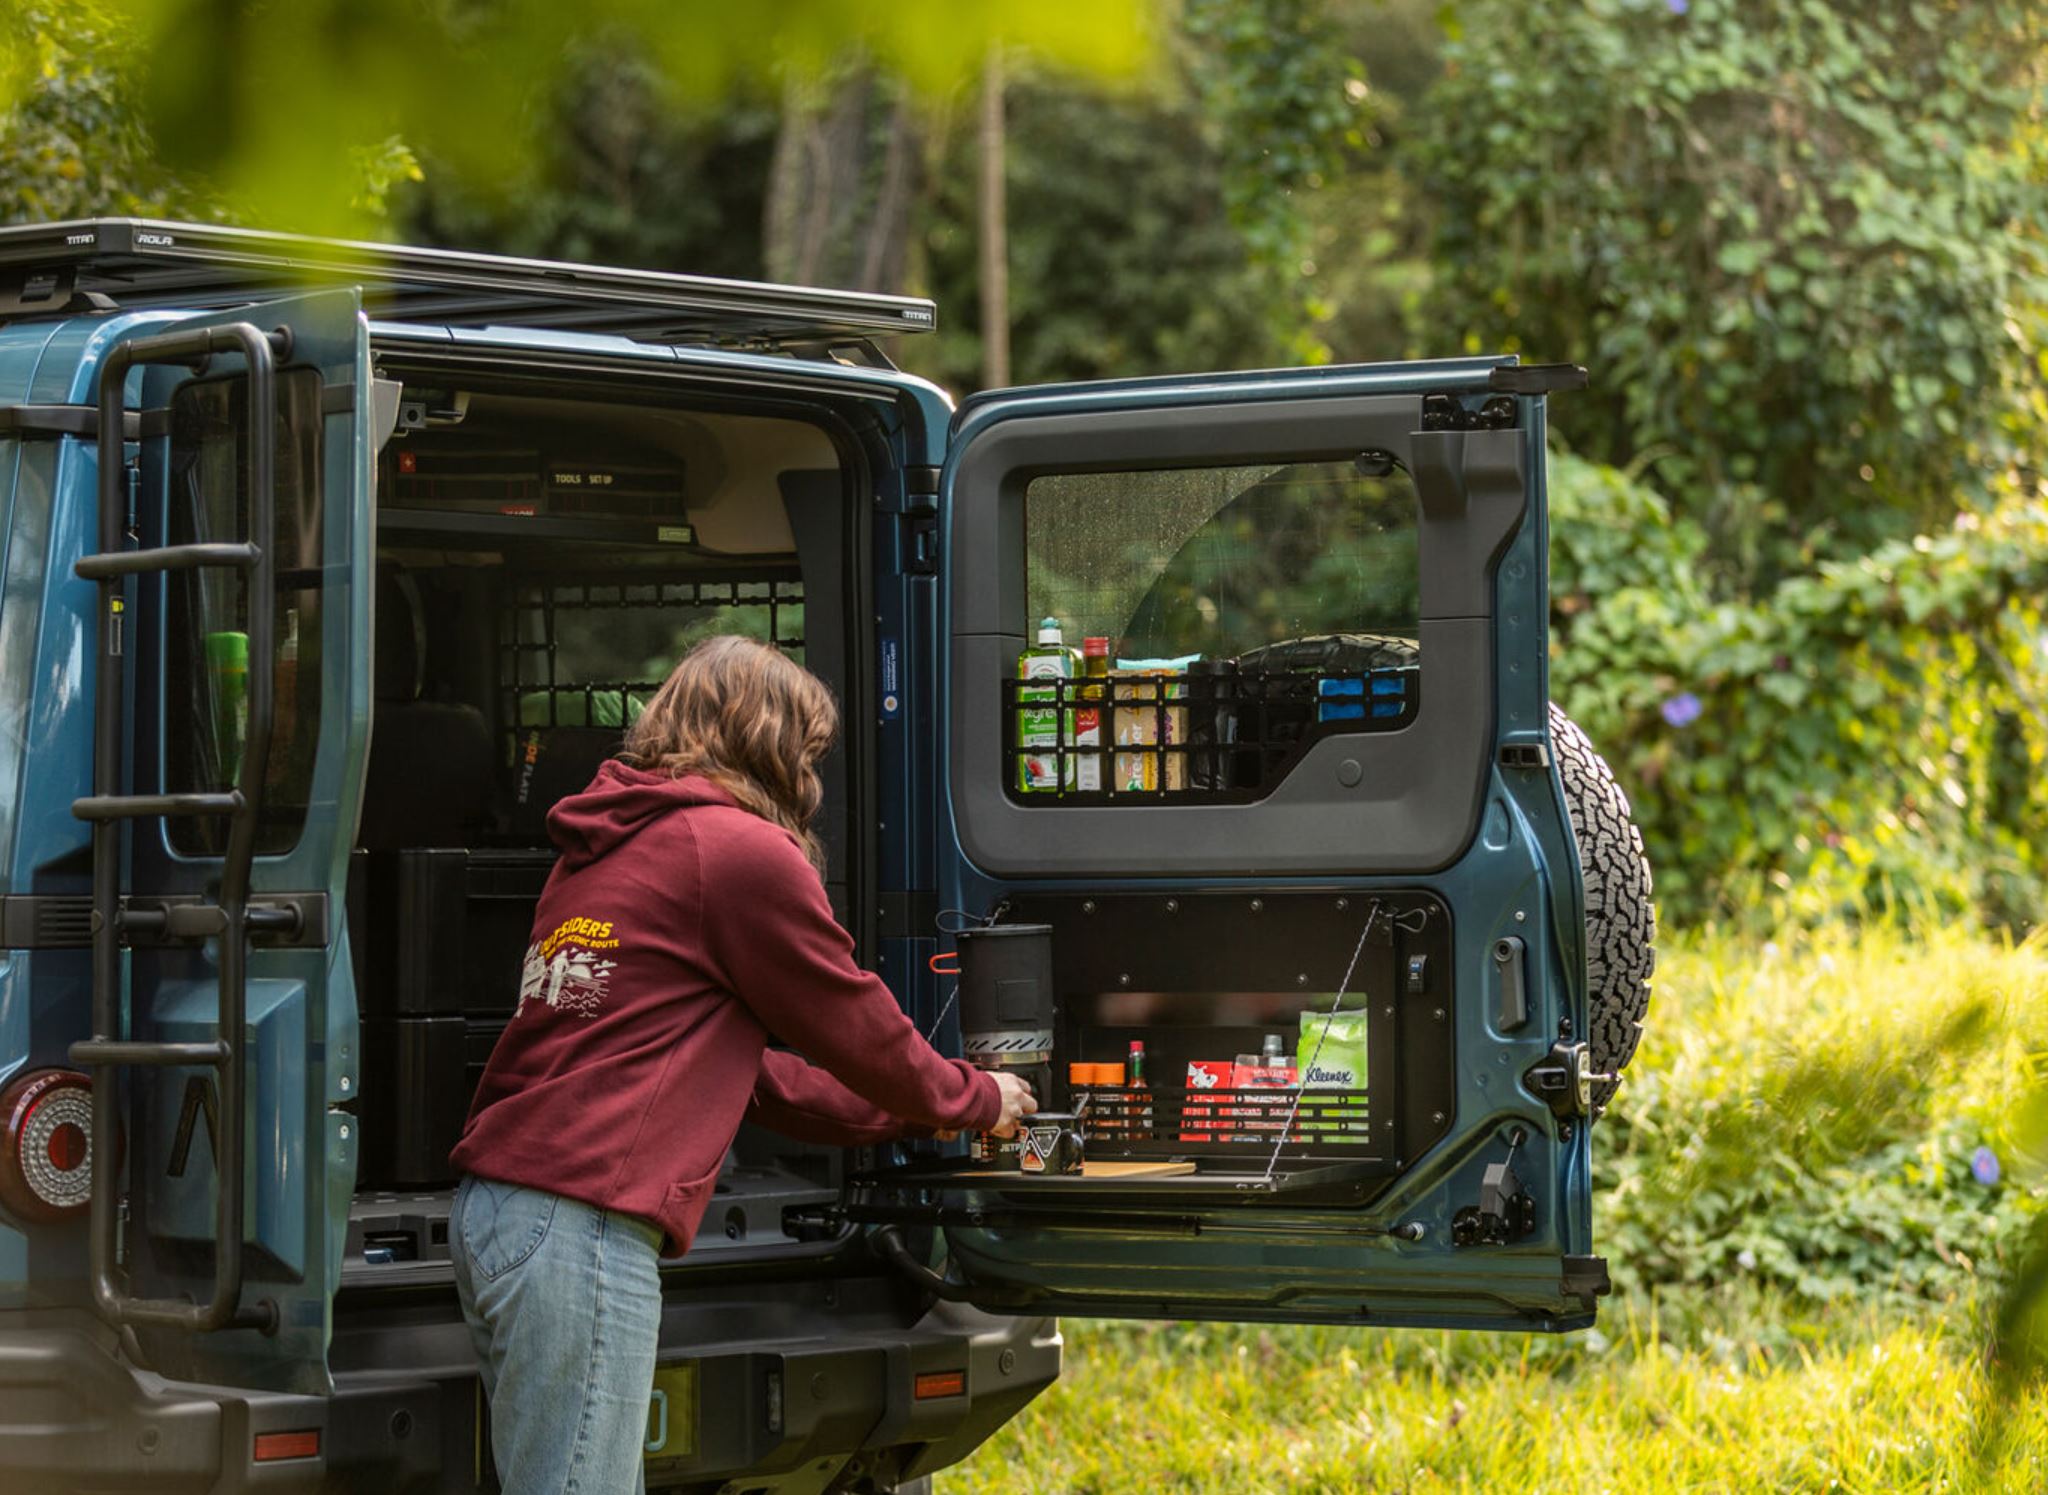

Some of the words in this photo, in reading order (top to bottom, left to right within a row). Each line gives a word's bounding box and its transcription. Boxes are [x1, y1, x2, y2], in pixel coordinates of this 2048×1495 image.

[66, 234, 95, 245] TITAN
[138, 234, 173, 246] ROLA
[555, 474, 582, 484] TOOLS
[589, 475, 602, 484] SET
[590, 938, 620, 949] ROUTE
[1306, 1067, 1353, 1084] Kleenex
[999, 1143, 1021, 1152] JETP
